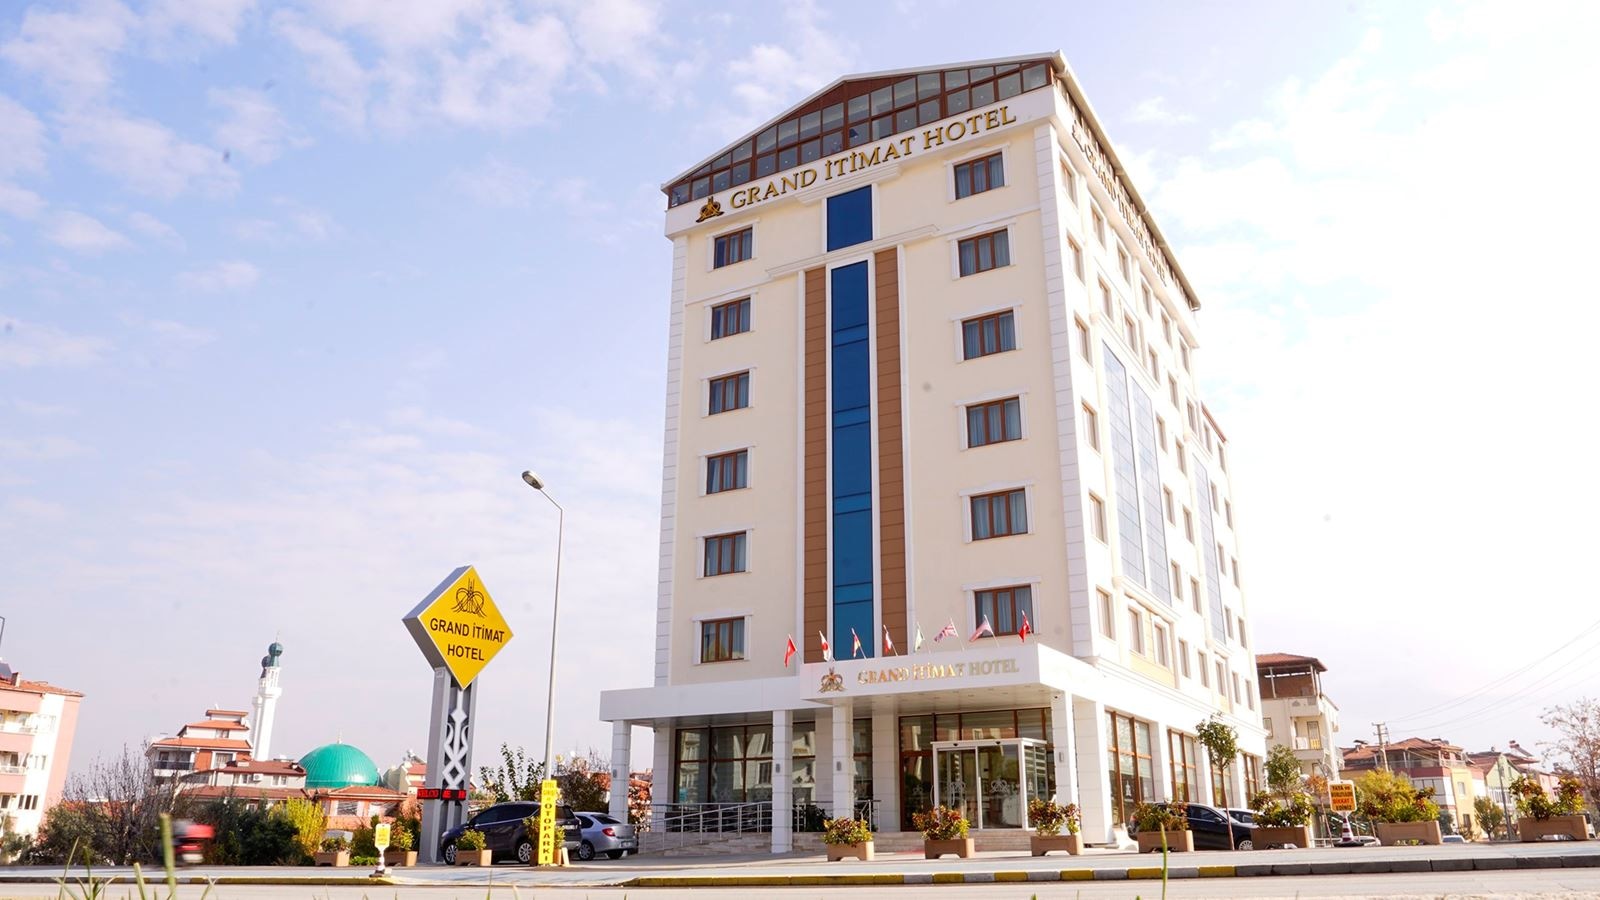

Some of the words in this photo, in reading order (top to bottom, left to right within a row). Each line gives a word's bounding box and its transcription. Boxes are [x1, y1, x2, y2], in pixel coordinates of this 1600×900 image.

[729, 168, 817, 210] GRAND
[824, 136, 916, 182] İTİMAT
[923, 106, 1016, 150] HOTEL
[429, 617, 470, 637] GRAND
[472, 622, 505, 643] İTİMAT
[447, 643, 485, 661] HOTEL
[857, 667, 909, 686] GRAND
[969, 658, 1020, 676] HOTEL
